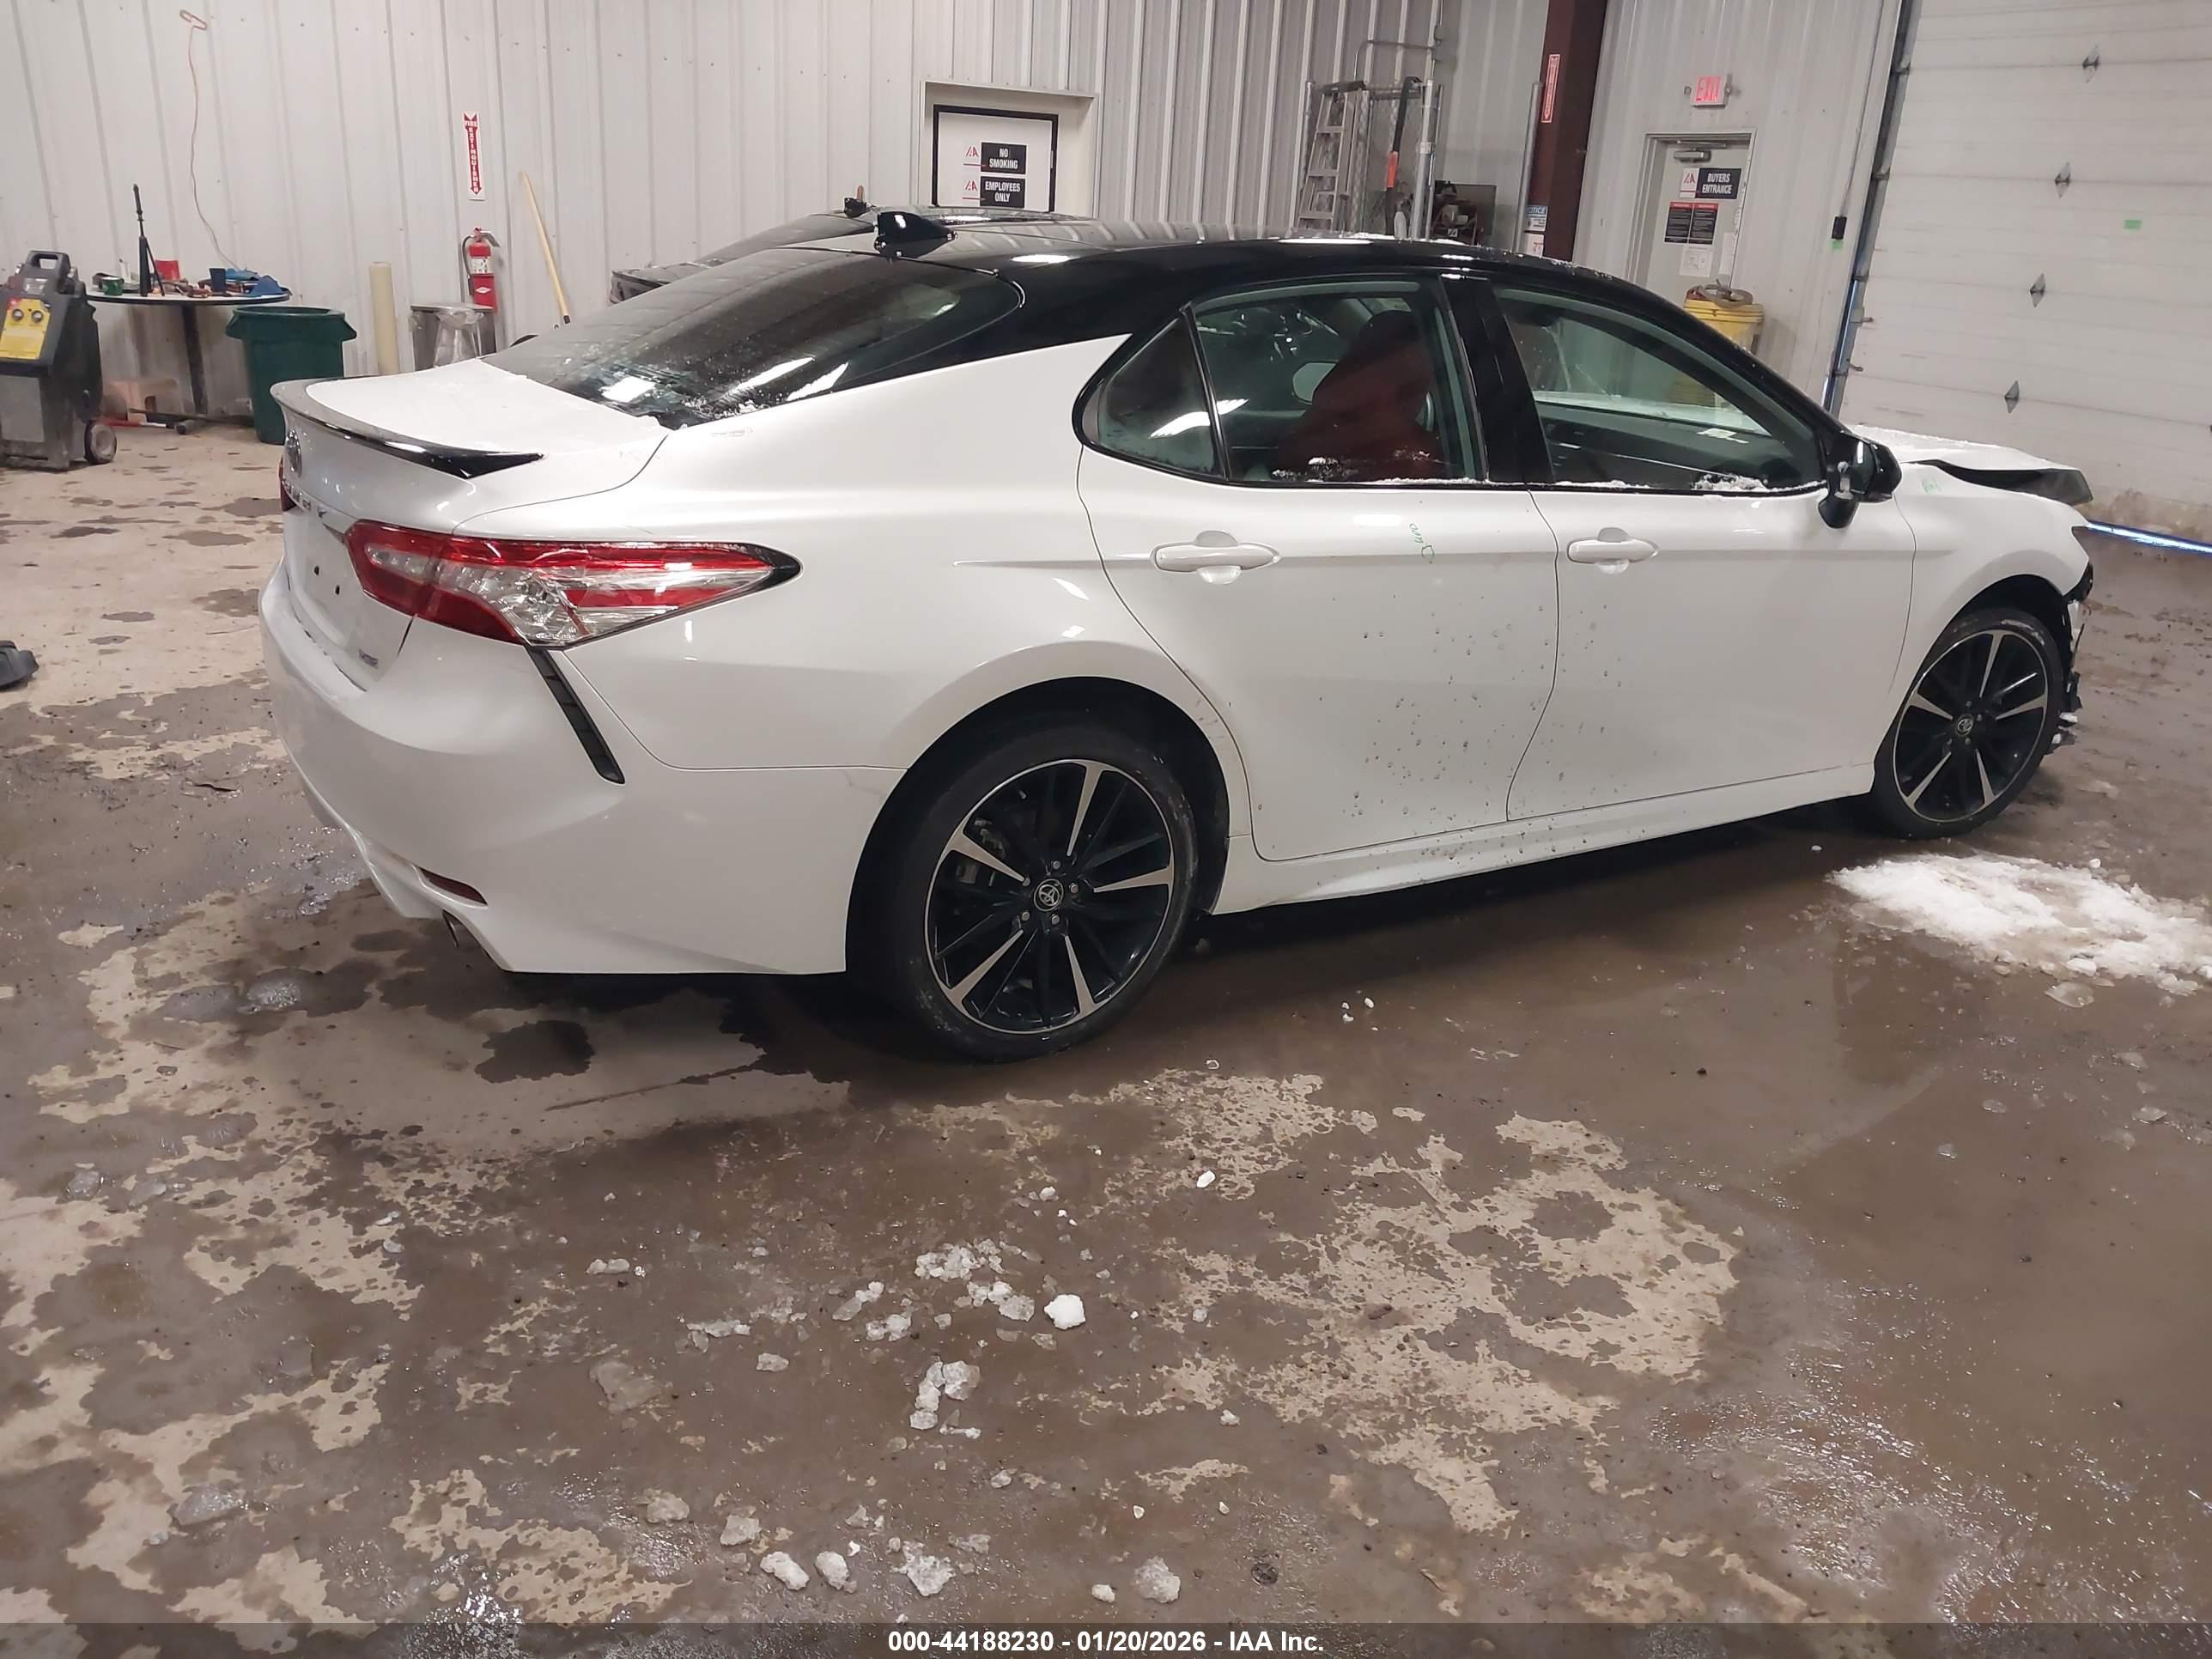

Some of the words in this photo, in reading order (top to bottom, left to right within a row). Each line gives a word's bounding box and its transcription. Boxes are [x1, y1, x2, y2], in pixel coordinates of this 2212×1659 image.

[999, 148, 1009, 158] NO
[988, 158, 1018, 170] SMOKING
[1707, 173, 1731, 183] BUYERS
[985, 180, 1021, 192] EMPLOYEES
[1702, 184, 1733, 195] ENTRANCE
[994, 191, 1011, 203] ONLY
